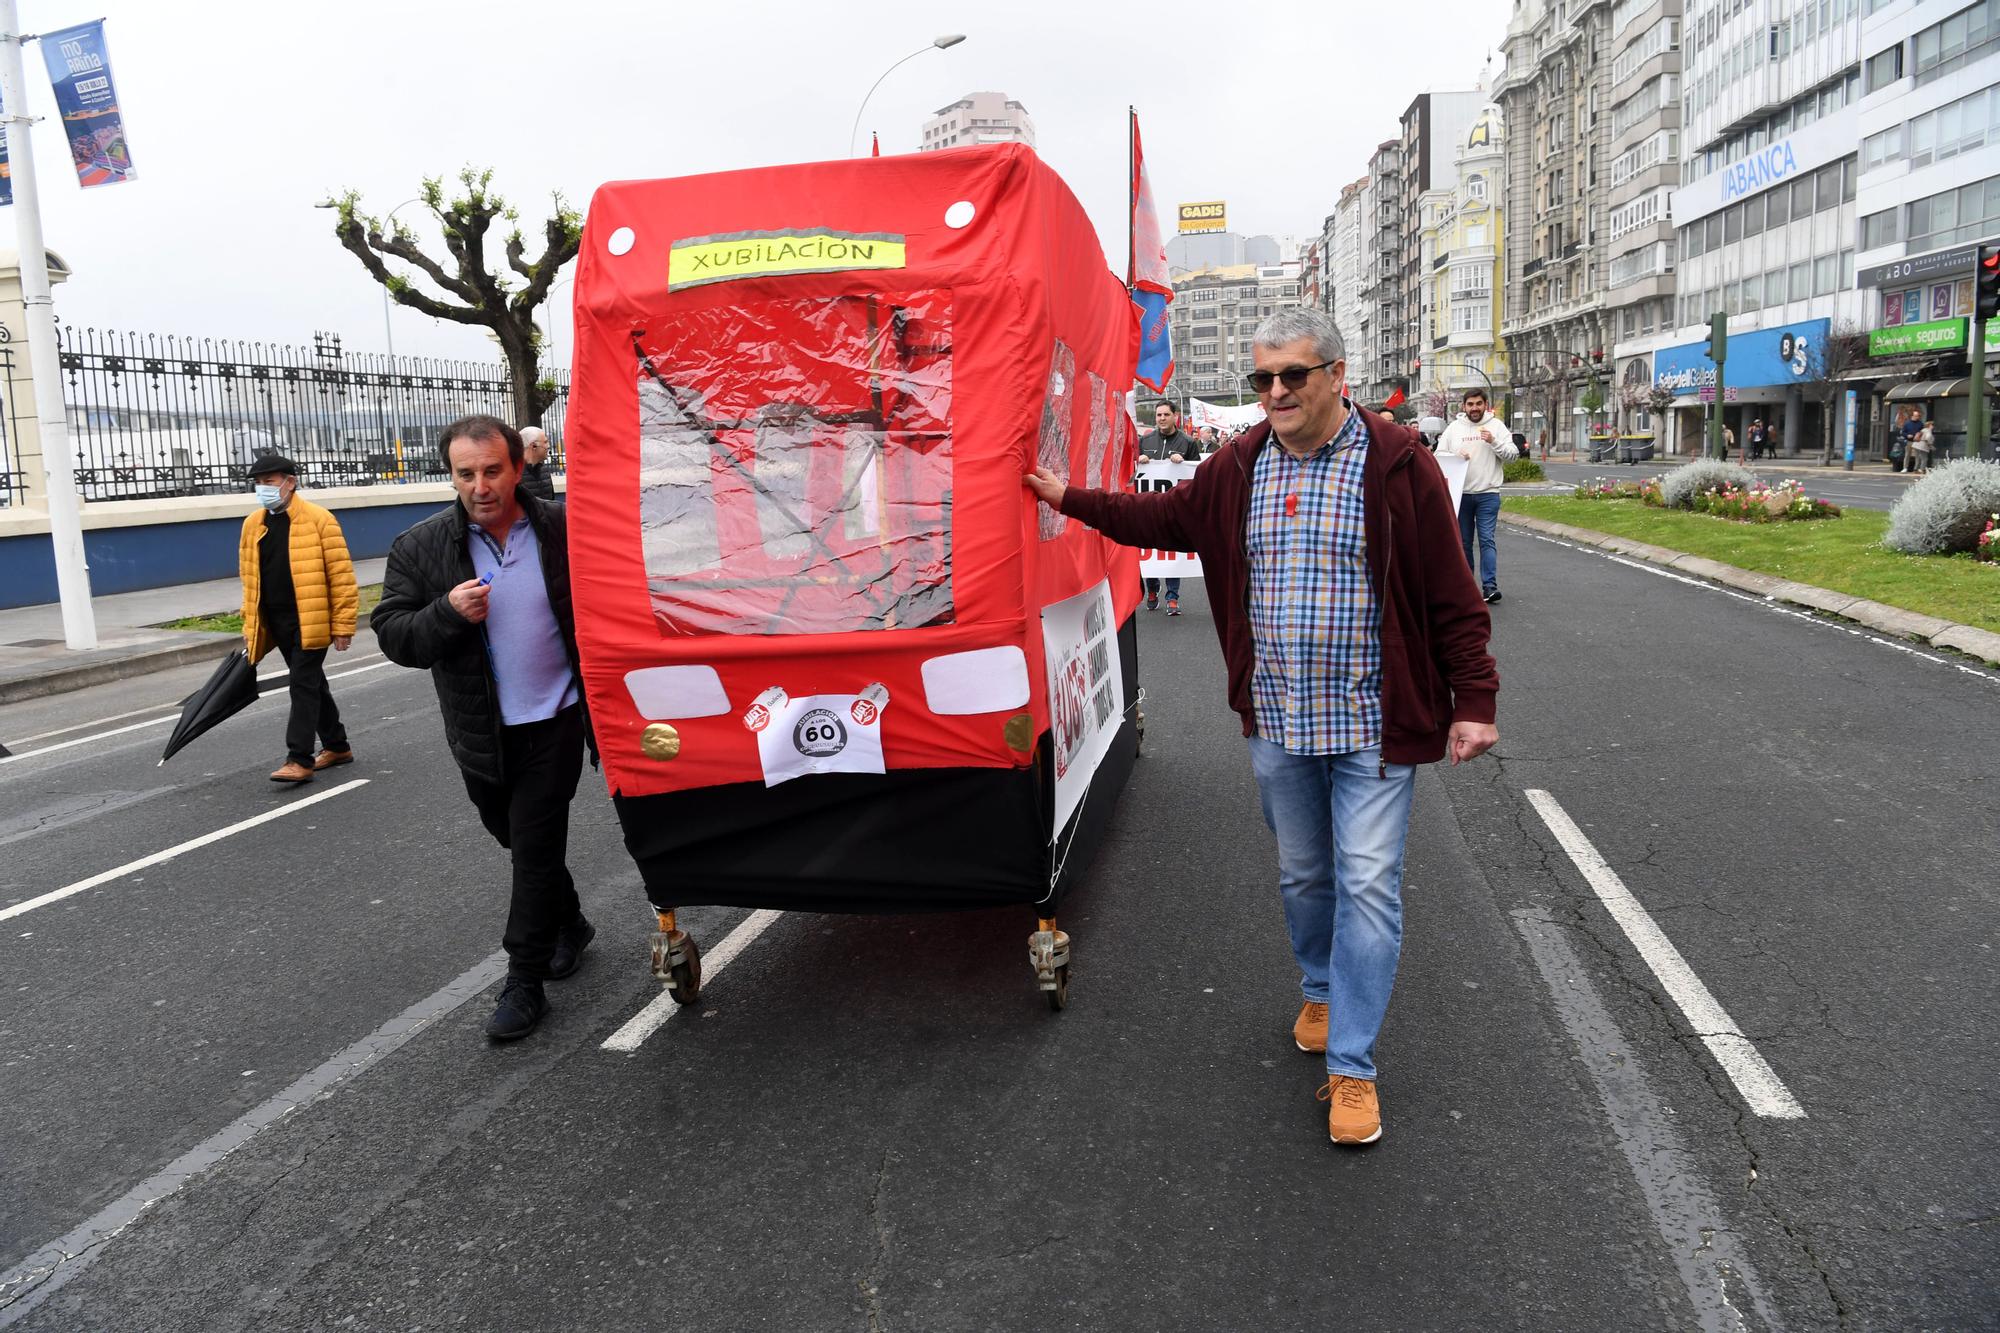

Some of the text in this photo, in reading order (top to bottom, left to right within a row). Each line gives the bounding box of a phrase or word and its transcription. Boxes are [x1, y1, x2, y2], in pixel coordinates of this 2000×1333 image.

[1728, 140, 1797, 199] ABANCA
[1182, 205, 1223, 218] GADIS
[1917, 327, 1956, 346] seguros
[744, 705, 767, 723] UGT
[852, 701, 870, 719] UGT
[805, 725, 835, 743] 60
